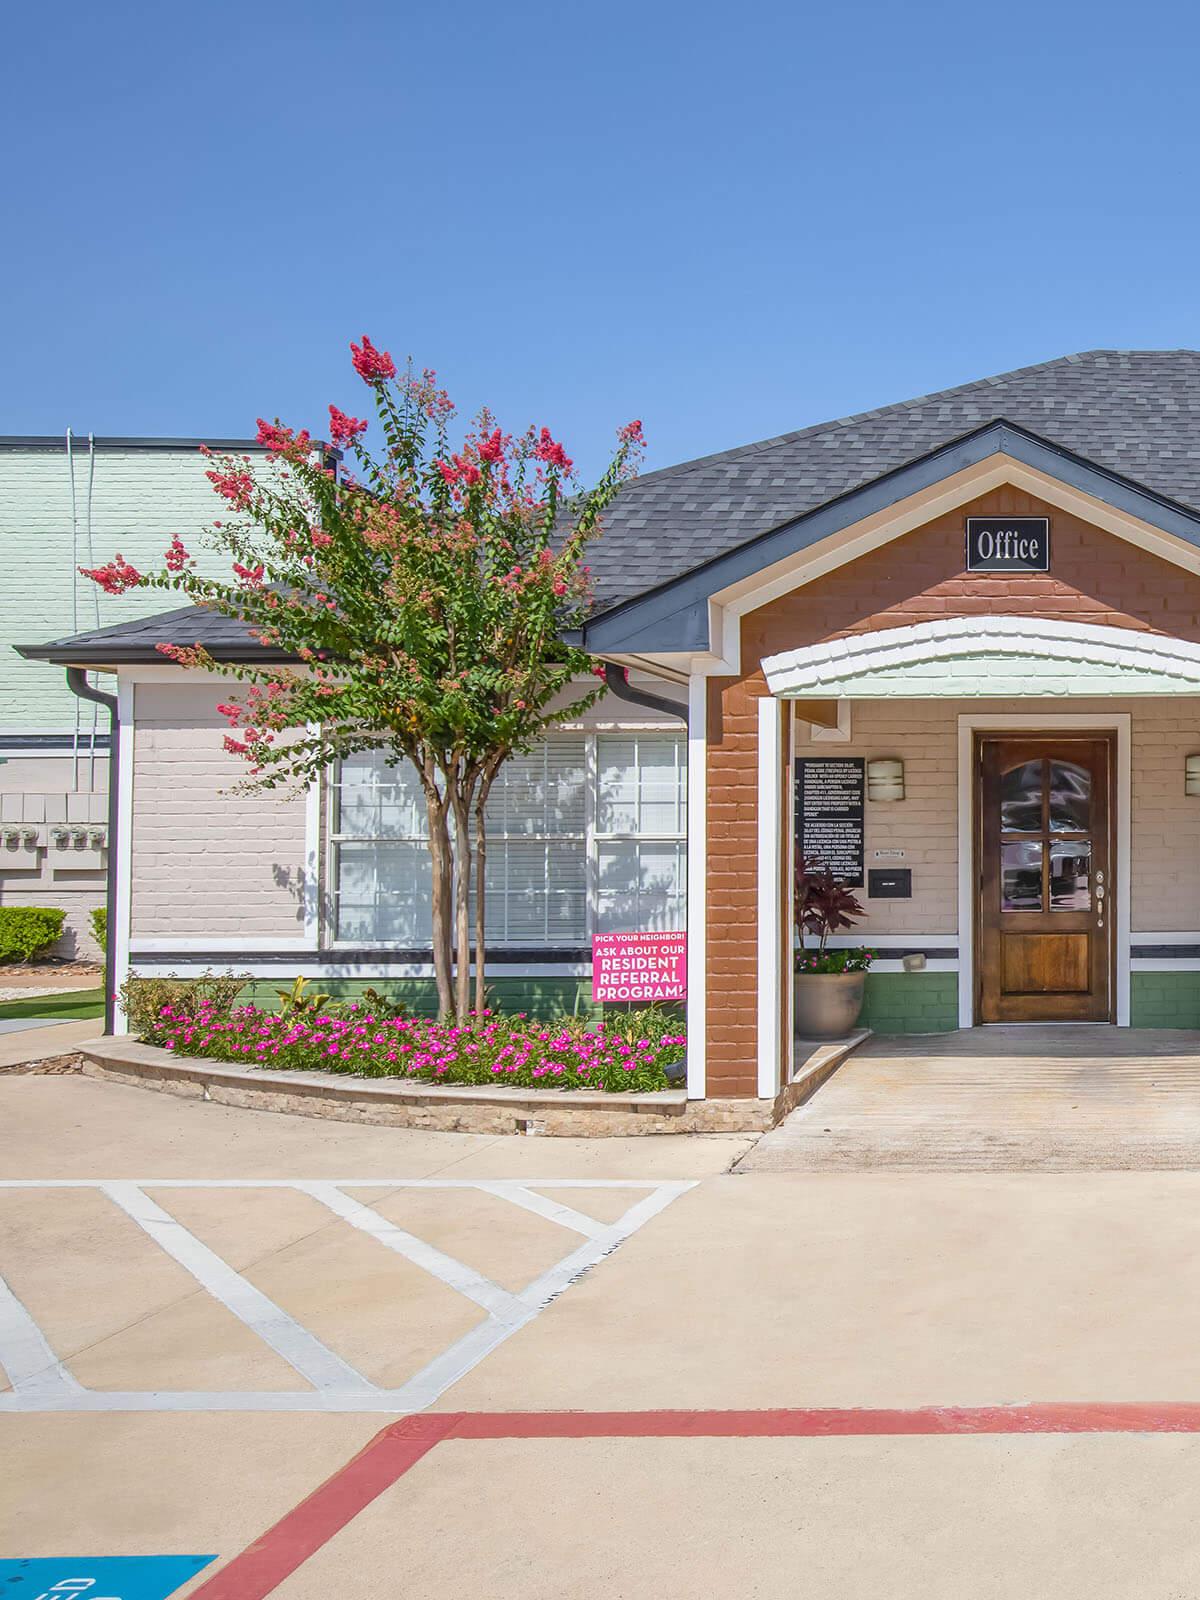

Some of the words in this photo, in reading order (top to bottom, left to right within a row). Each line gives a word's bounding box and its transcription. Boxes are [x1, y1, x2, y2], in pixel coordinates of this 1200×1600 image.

[977, 530, 1039, 559] Office
[595, 935, 615, 943] PICK
[616, 934, 638, 942] YOUR
[640, 933, 685, 941] NEIGHBOR!
[595, 947, 617, 957] ASK
[620, 946, 659, 956] ABOUT
[660, 945, 685, 954] OUR
[601, 956, 679, 971] RESIDENT
[600, 971, 681, 985] REFERRAL
[597, 985, 684, 1000] PROGRAM!
